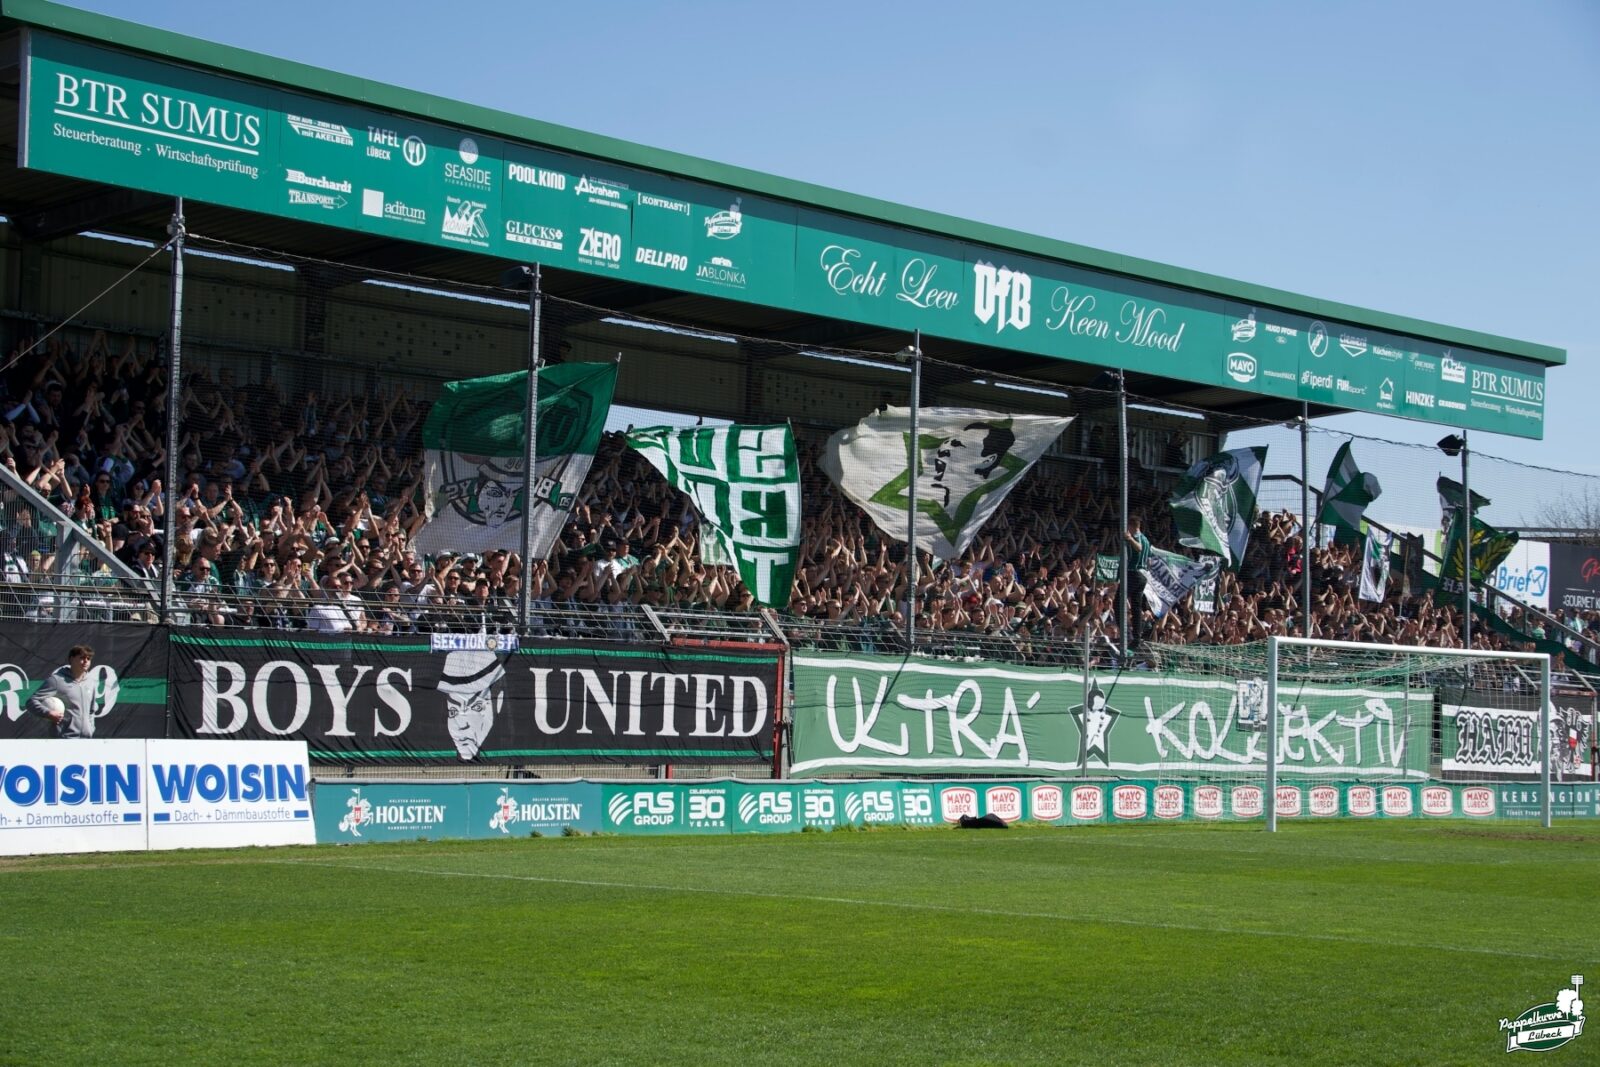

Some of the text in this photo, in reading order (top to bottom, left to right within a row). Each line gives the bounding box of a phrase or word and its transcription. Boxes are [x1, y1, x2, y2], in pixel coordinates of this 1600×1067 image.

[55, 72, 260, 147] BTR SUMUS
[315, 132, 353, 146] AKELBEIN
[368, 126, 400, 148] TAFEL
[53, 122, 142, 156] Steuerberatung
[155, 143, 259, 179] Wirtschaftsprüfung
[366, 146, 391, 160] LÜBECK
[445, 163, 491, 186] SEASIDE
[574, 174, 620, 198] Abraham
[384, 201, 425, 220] aditum
[635, 247, 688, 271] DELLPRO
[695, 265, 746, 284] JABLONKA
[819, 245, 959, 310] Echt Leev
[1045, 286, 1110, 339] Keen
[1115, 300, 1185, 353] Mood
[1230, 358, 1255, 373] MAYO
[1471, 369, 1543, 402] BTR SUMUS
[1405, 390, 1435, 408] HINZKE
[432, 634, 486, 650] SEKTION
[194, 659, 413, 738] BOYS
[530, 667, 769, 738] UNITED
[0, 764, 141, 807] OISIN
[152, 764, 307, 804] WOISIN
[633, 791, 675, 814] FLS
[759, 791, 792, 813] FLS
[862, 791, 894, 812] FLS
[947, 793, 971, 804] MAYO
[992, 792, 1015, 803] MAYO
[1037, 791, 1058, 802] MAYO
[1075, 791, 1098, 801] MAYO
[1119, 791, 1141, 801] MAYO
[1158, 791, 1179, 801] MAYO
[1198, 791, 1218, 801] MAYO
[1236, 791, 1258, 800] MAYO
[1276, 791, 1297, 800] MAYO
[1314, 791, 1334, 800] MAYO
[1352, 791, 1371, 800] MAYO
[1386, 791, 1407, 800] MAYO
[1426, 791, 1447, 800] MAYO
[1466, 792, 1489, 801] MAYO
[1501, 791, 1591, 803] KENSNGTON
[521, 803, 581, 821] HOLSTEN
[688, 795, 726, 819] 30
[804, 795, 835, 818] 30
[903, 794, 932, 816] 30
[26, 811, 119, 826] Dämmbaustoffe
[215, 807, 291, 821] Dämmbaustoffe
[376, 805, 444, 823] HOLSTEN
[633, 815, 674, 825] GROUP
[759, 814, 792, 824] GROUP
[864, 812, 895, 822] GROUP
